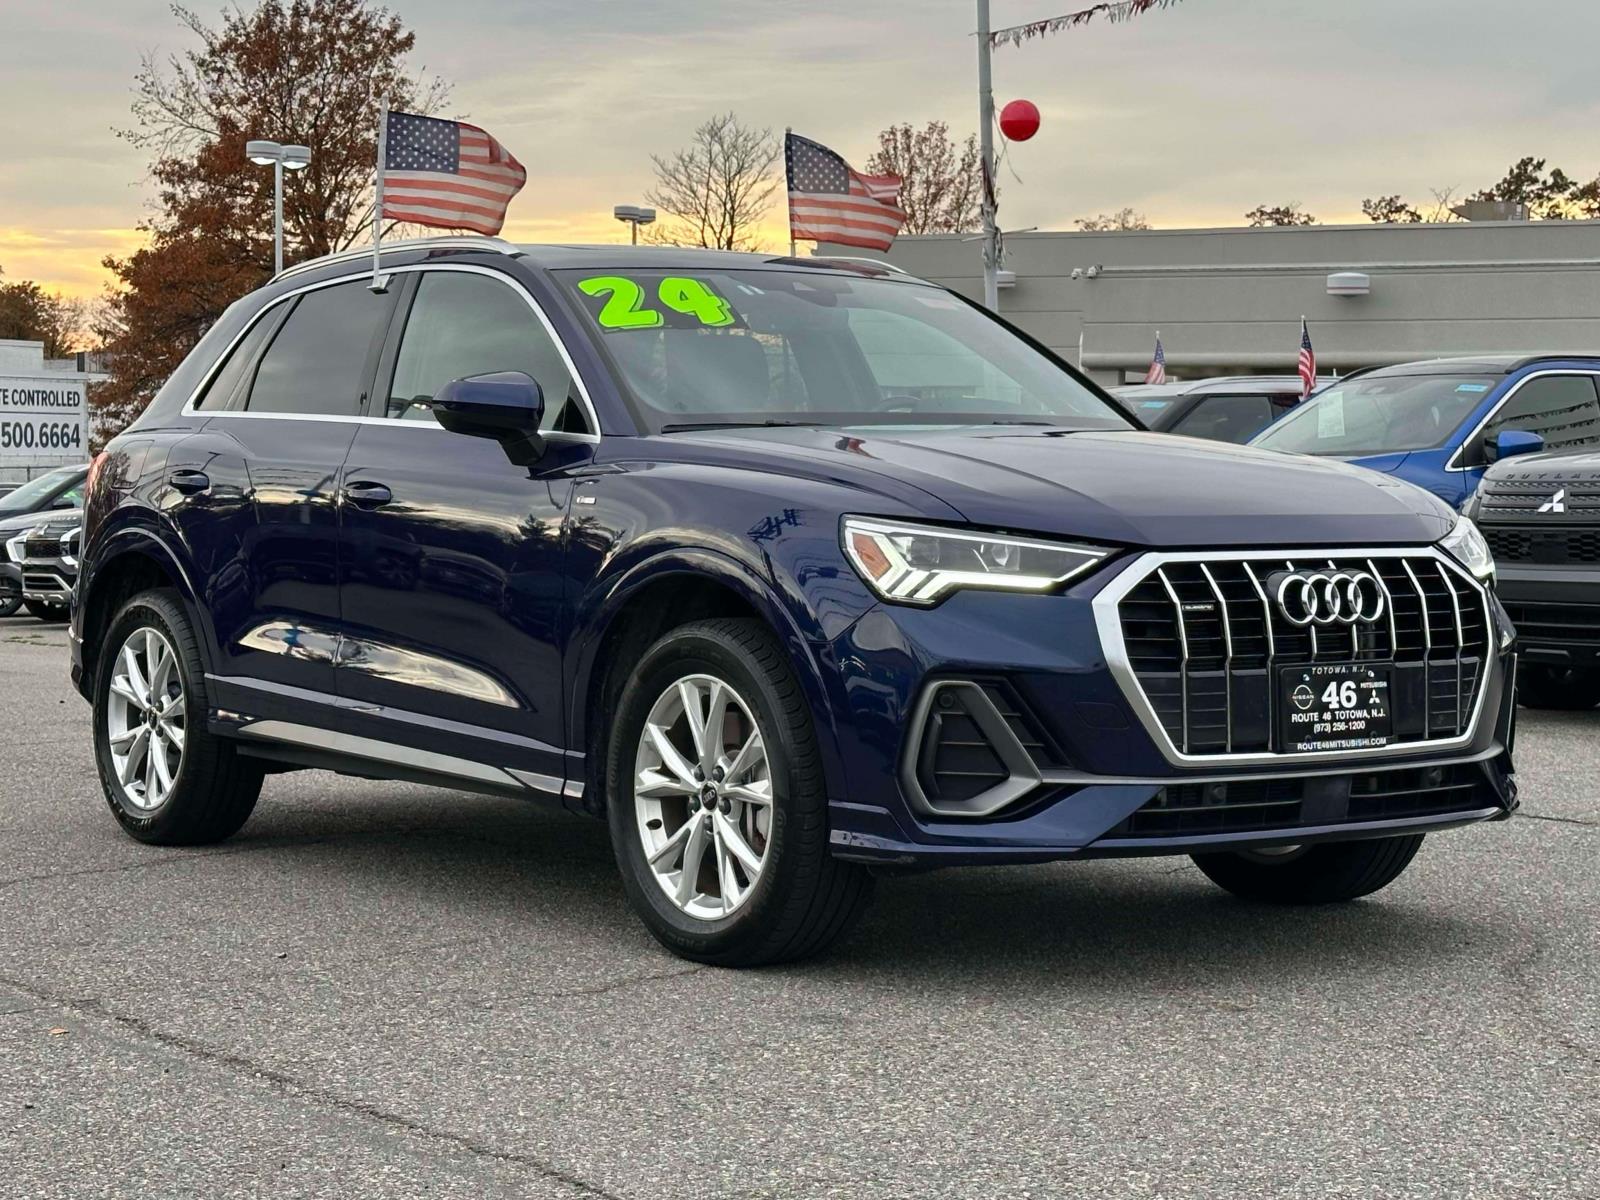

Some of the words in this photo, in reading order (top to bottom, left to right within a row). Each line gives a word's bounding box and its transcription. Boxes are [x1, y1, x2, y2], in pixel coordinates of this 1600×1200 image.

[577, 276, 736, 330] 24
[0, 388, 9, 405] E
[11, 389, 80, 406] CONTROLLED
[1, 422, 80, 448] 500.6664
[1321, 680, 1358, 709] 46
[1291, 712, 1319, 723] ROUTE
[1322, 711, 1332, 720] 46
[1371, 708, 1386, 718] N.J.
[1313, 722, 1332, 734] (973)
[1332, 720, 1366, 731] 256-1200
